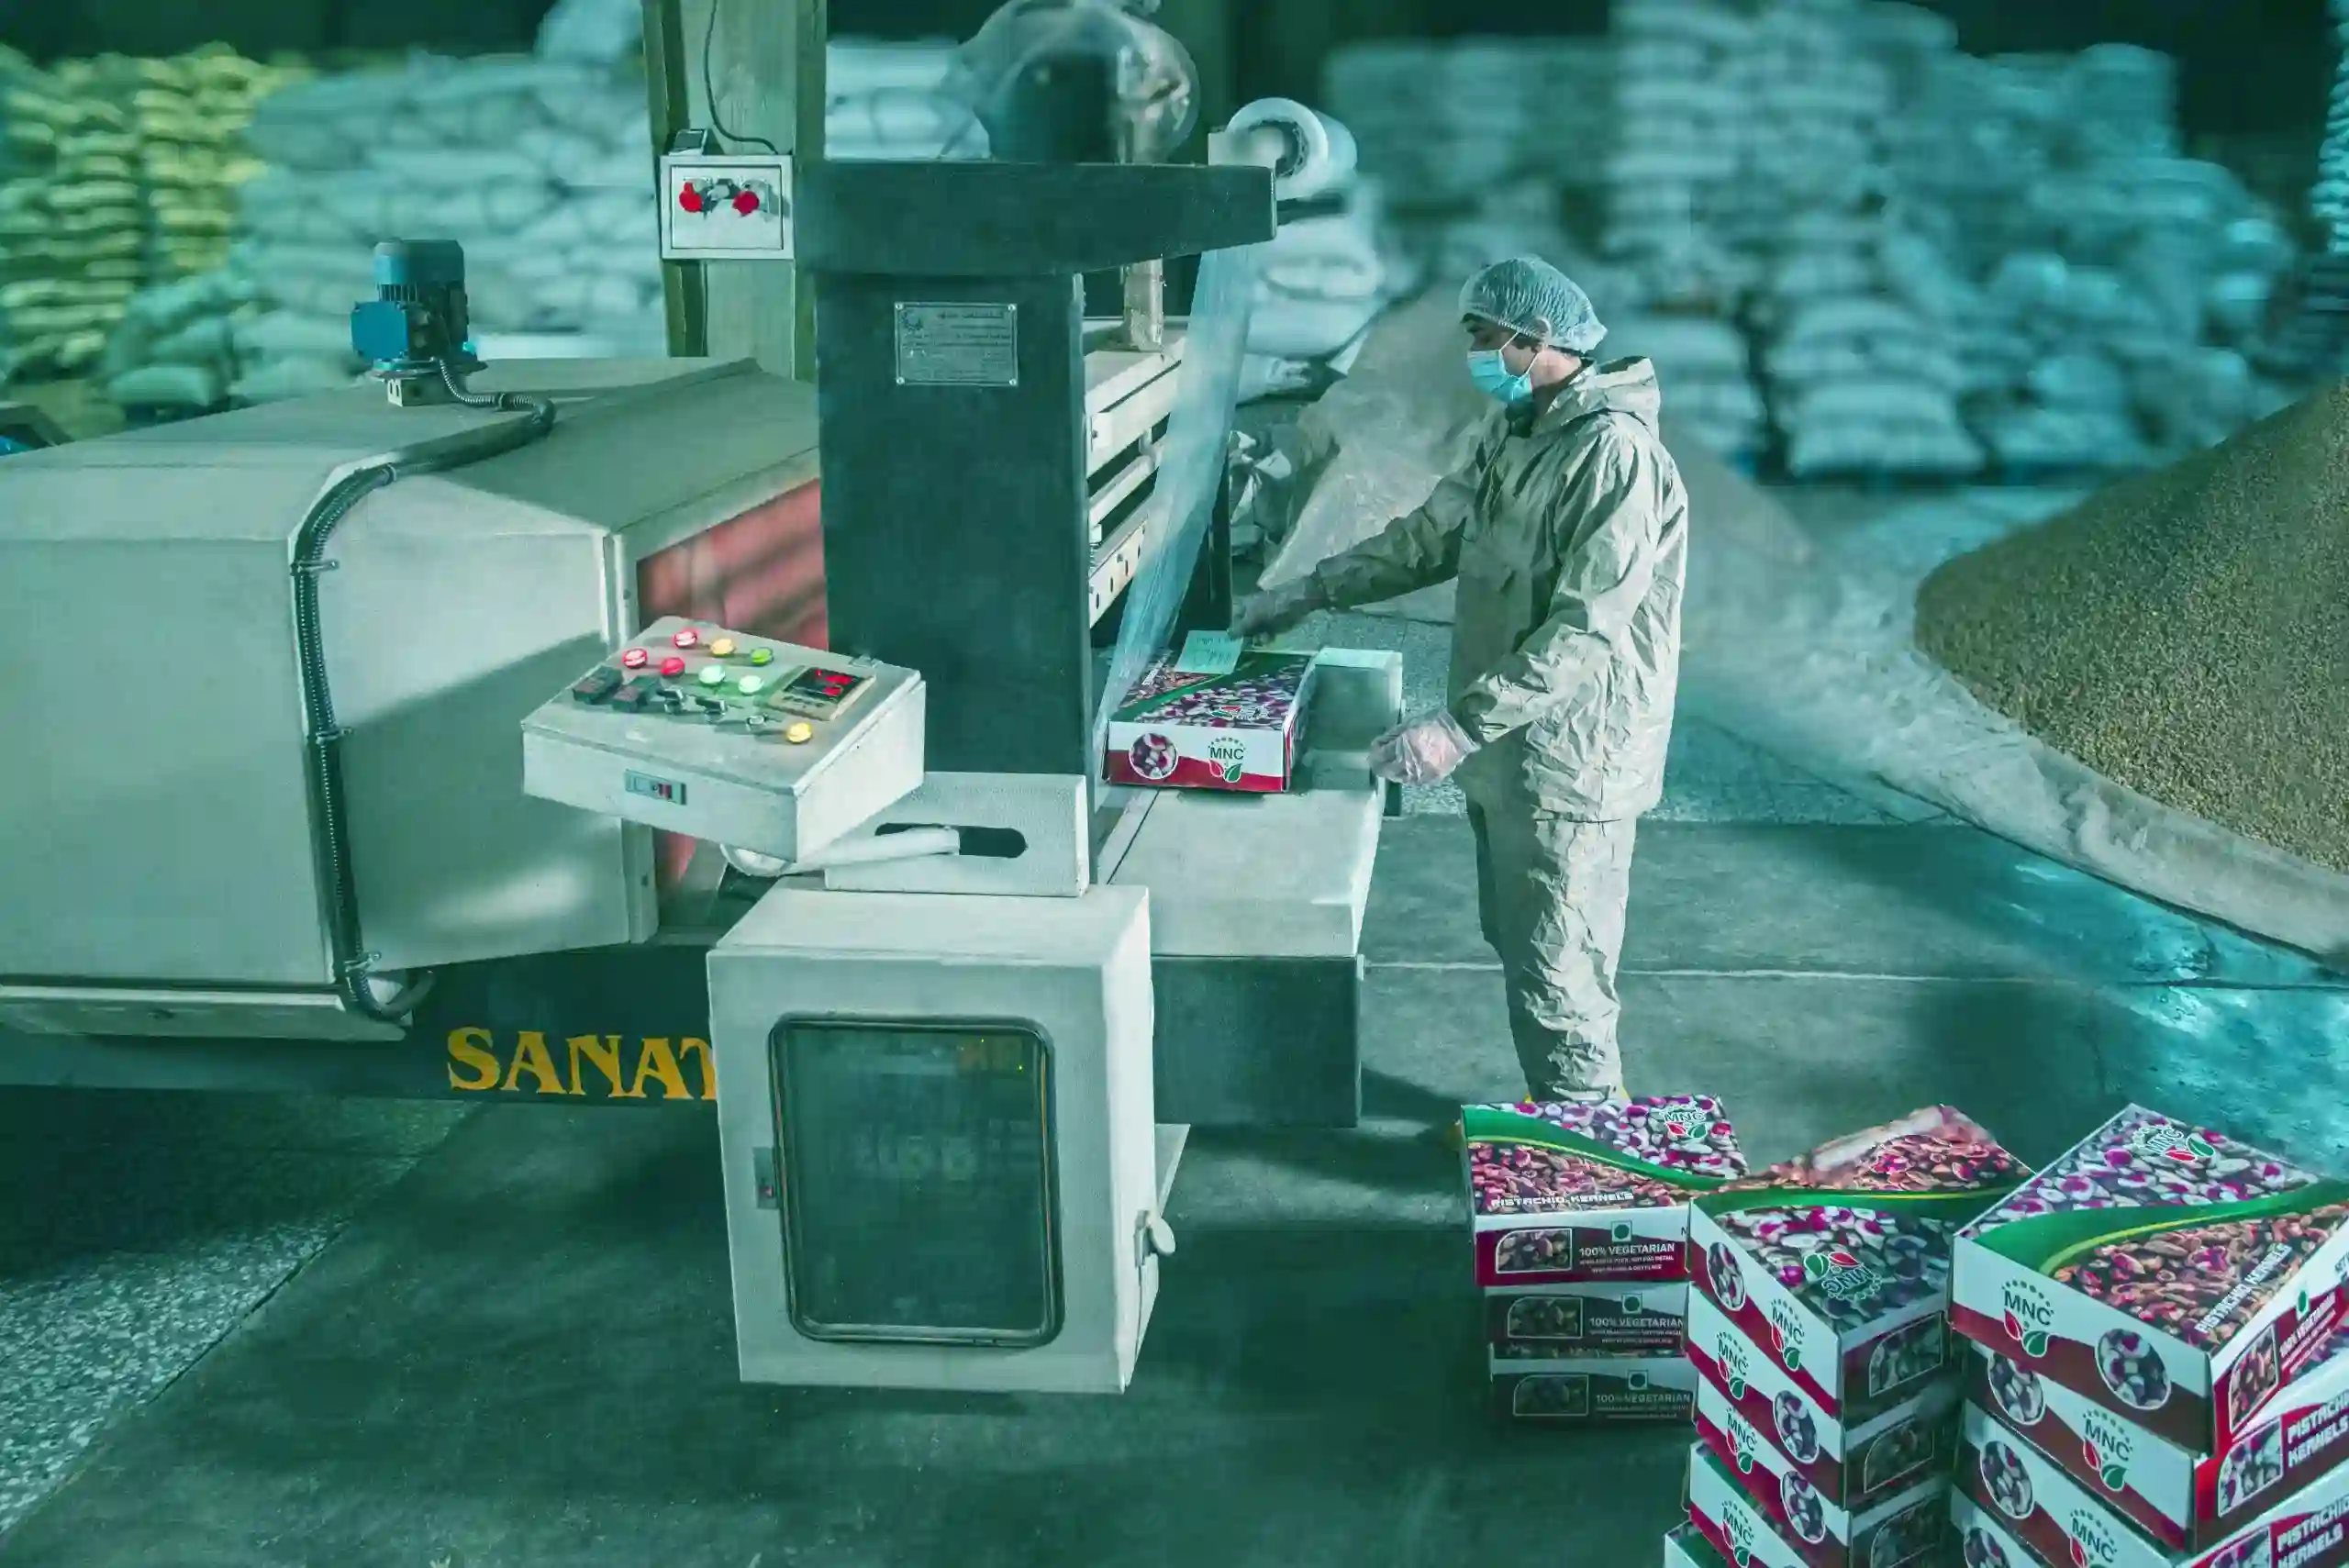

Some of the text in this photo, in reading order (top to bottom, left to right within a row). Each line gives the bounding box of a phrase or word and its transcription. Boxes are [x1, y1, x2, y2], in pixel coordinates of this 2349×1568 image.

[1210, 747, 1244, 761] MNC
[1664, 1107, 1708, 1122] MNC
[1491, 1192, 1634, 1207] PISTACHIO KERNELS
[1579, 1242, 1675, 1258] 100% VEGETARIAN
[1821, 1265, 1876, 1296] MNC
[1619, 1316, 1684, 1329] VEGETARIAN
[1772, 1305, 1805, 1346] MNC
[2003, 1290, 2052, 1327] MNC
[2194, 1284, 2254, 1335] PISTACHIO
[1718, 1338, 1749, 1377] MNC
[1624, 1393, 1691, 1404] VEGETARIAN
[1727, 1412, 1756, 1452] MNC
[2085, 1419, 2131, 1462] MNC
[2288, 1415, 2349, 1468] KERNELS
[1723, 1507, 1754, 1547] MNC
[2072, 1518, 2115, 1563] MNC
